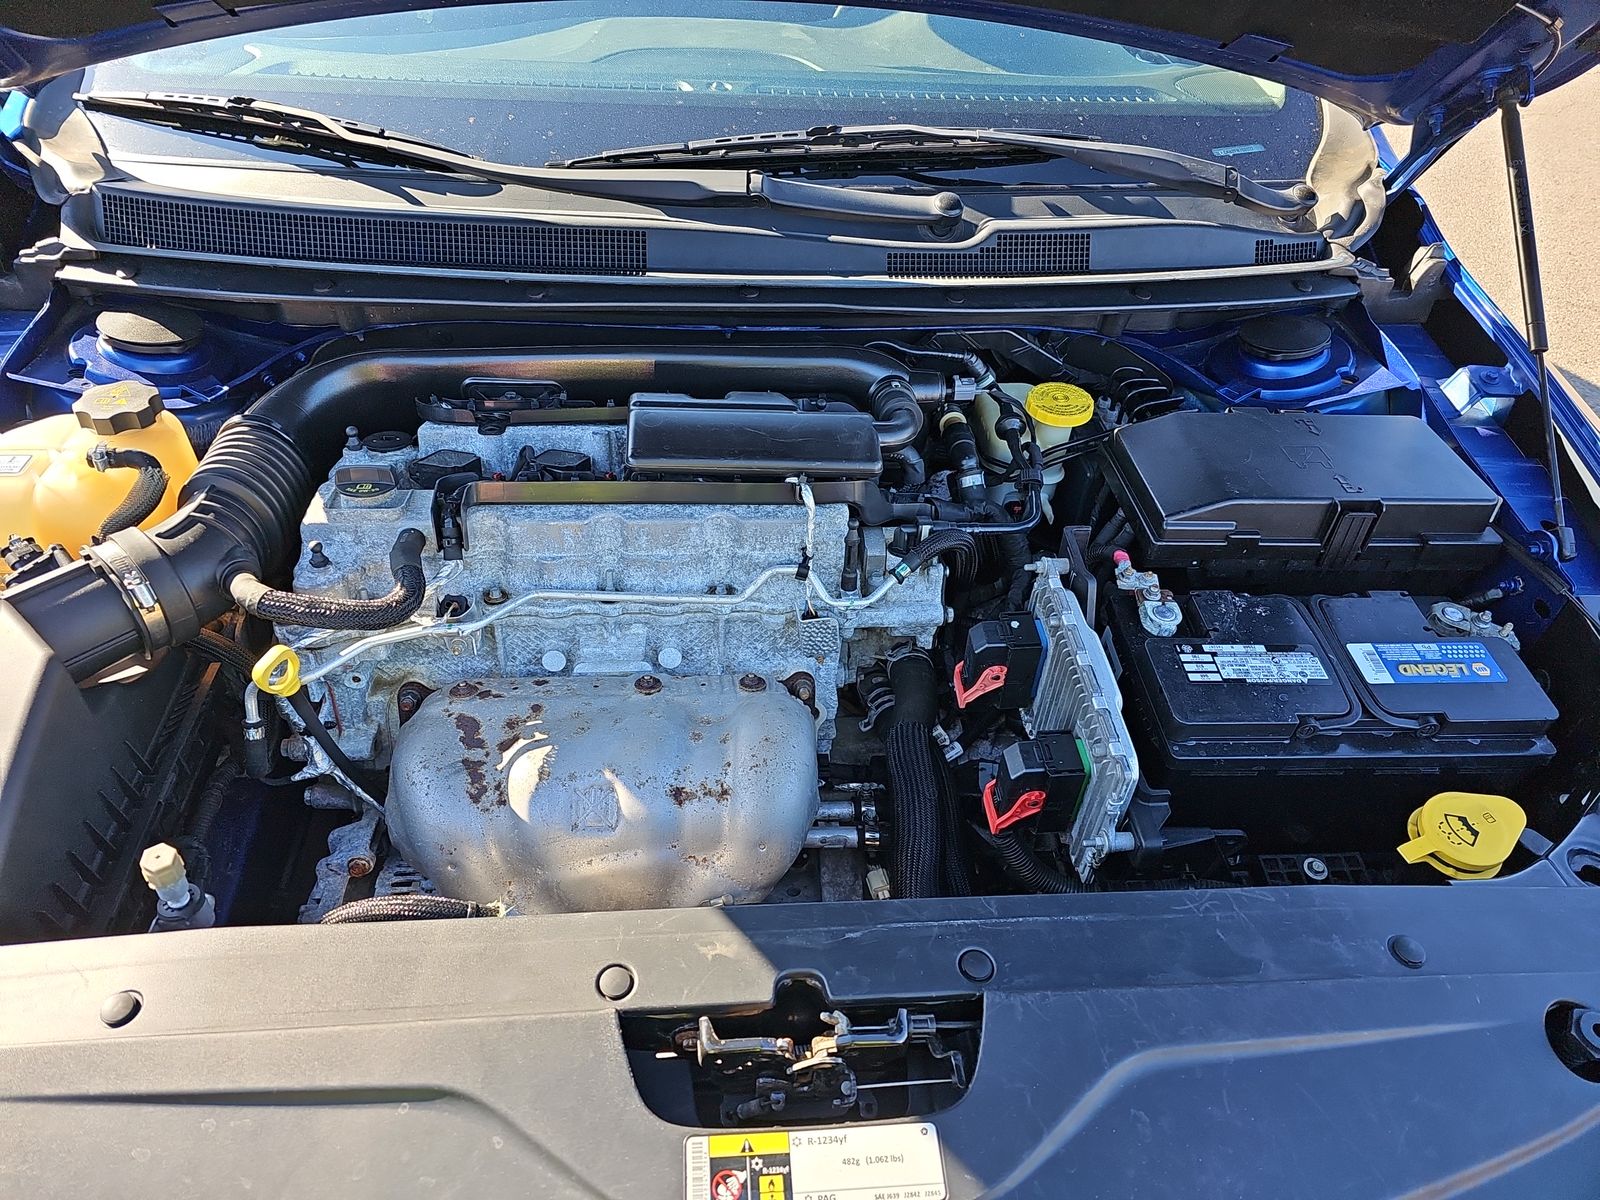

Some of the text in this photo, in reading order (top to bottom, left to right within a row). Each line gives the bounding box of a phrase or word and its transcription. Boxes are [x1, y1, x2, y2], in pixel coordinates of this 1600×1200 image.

[1398, 663, 1471, 677] LEGEND
[807, 1133, 847, 1146] R-1234yf
[842, 1154, 904, 1167] 482g (1.062 lbs)
